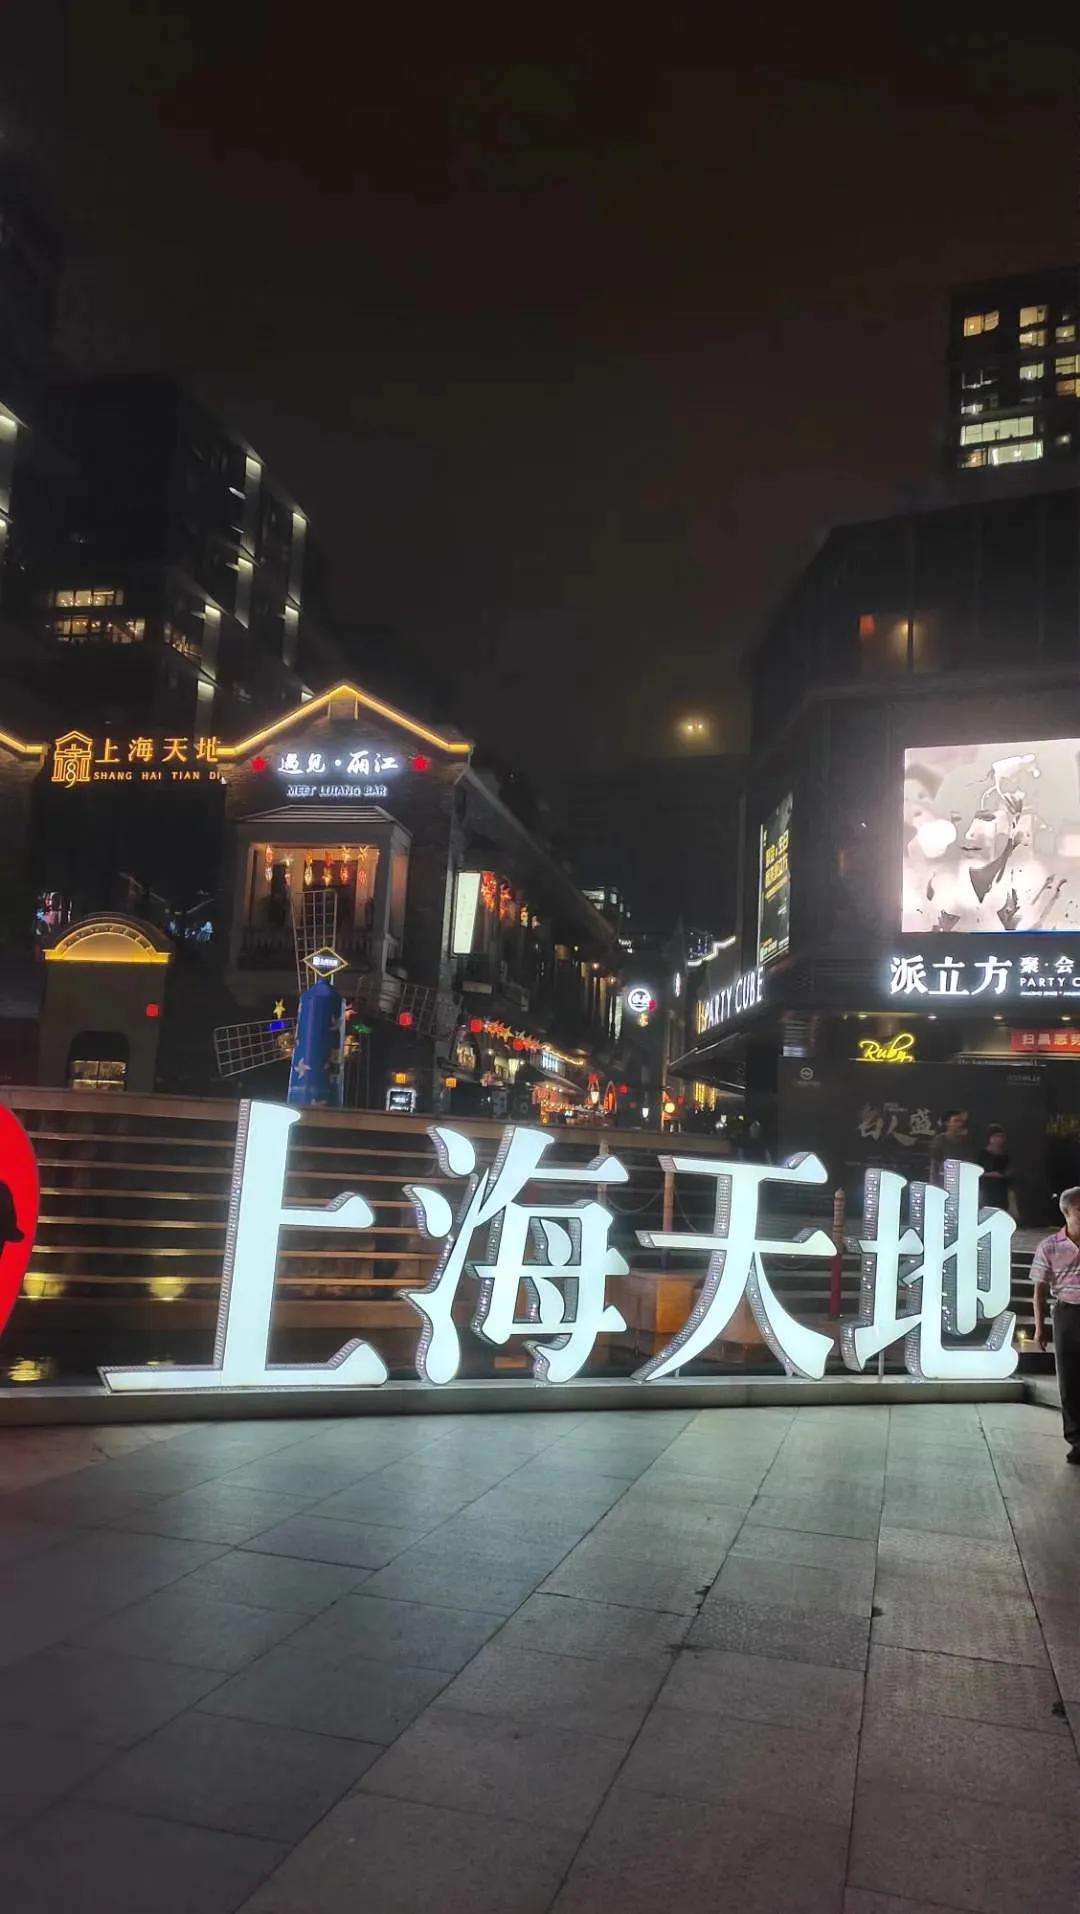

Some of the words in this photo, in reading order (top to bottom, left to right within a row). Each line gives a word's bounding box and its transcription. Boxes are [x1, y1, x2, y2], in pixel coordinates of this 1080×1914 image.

[95, 736, 219, 763] 上海天地
[93, 771, 132, 781] SHANG
[141, 771, 162, 781] HAI
[171, 771, 200, 781] TIAN
[209, 771, 221, 781] DI
[890, 954, 1013, 996] 派立方
[1020, 977, 1066, 987] PARTY
[699, 986, 733, 1034] PARTY
[735, 965, 764, 1015] CUBE
[856, 1033, 915, 1063] Ruby
[97, 1098, 1019, 1392] 上海天地
